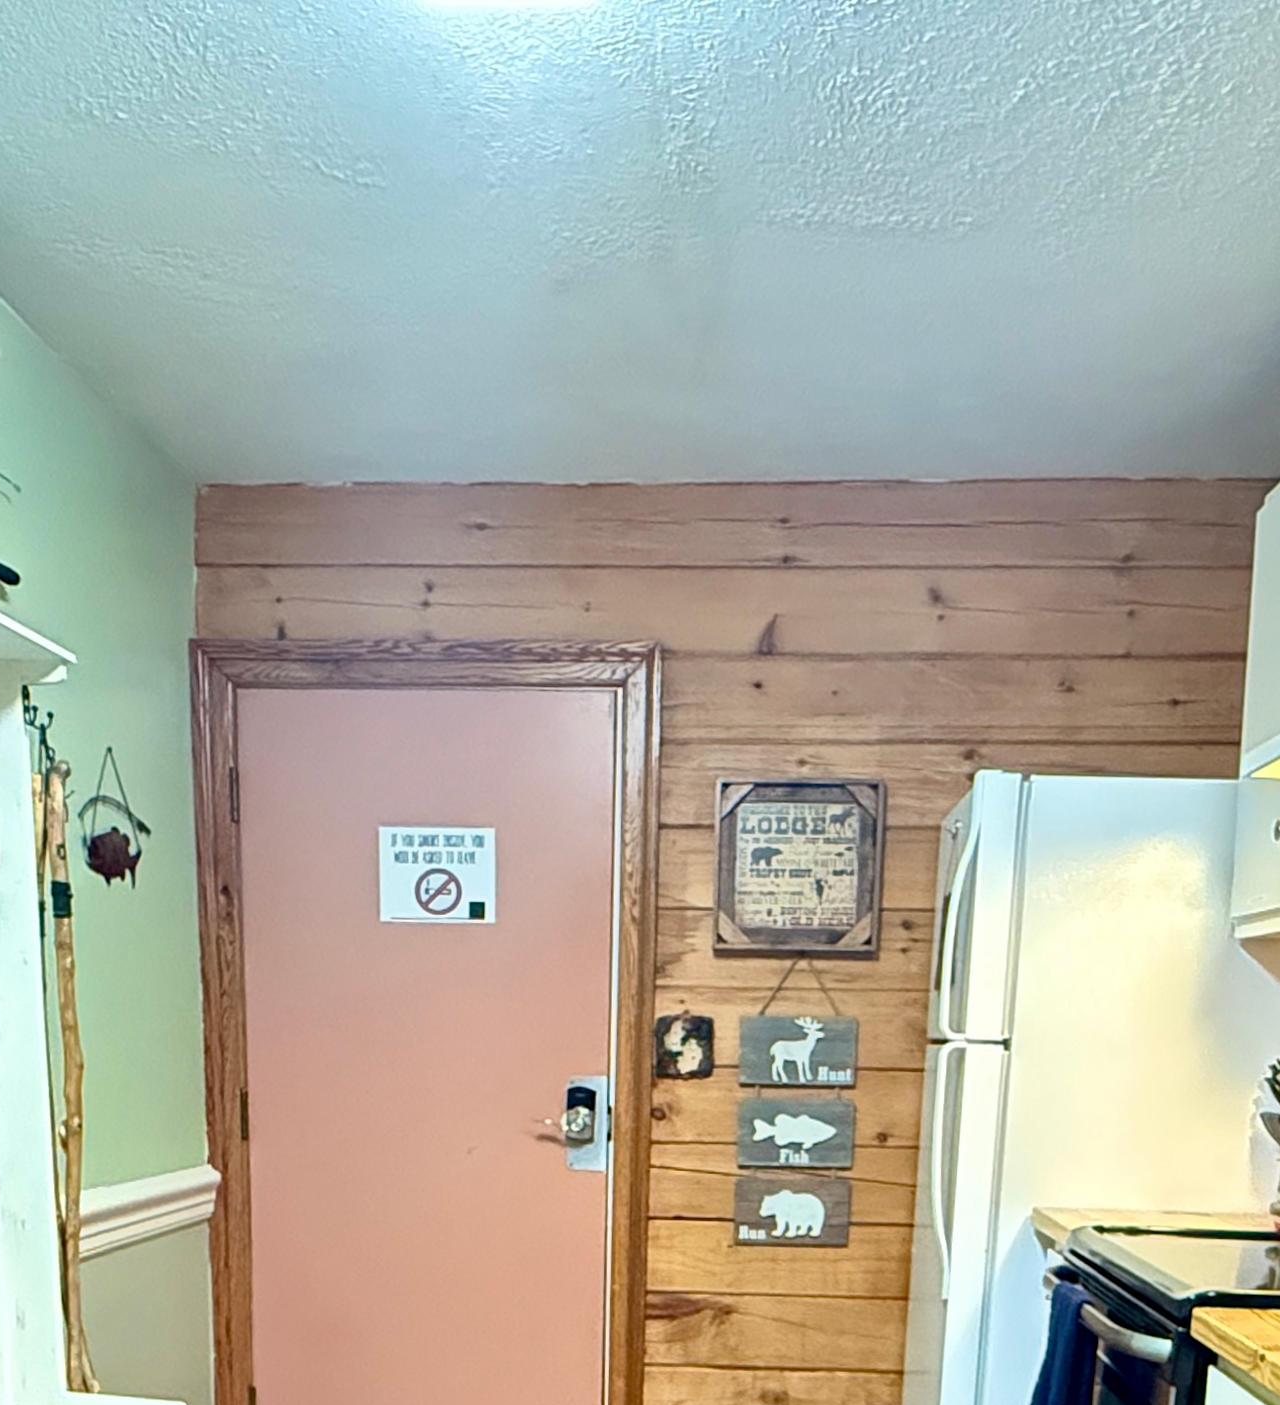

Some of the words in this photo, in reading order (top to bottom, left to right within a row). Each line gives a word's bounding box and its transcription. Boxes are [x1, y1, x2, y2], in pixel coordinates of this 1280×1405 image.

[740, 816, 826, 835] LODGE
[817, 1066, 852, 1082] Hunt
[779, 1149, 810, 1164] Fish
